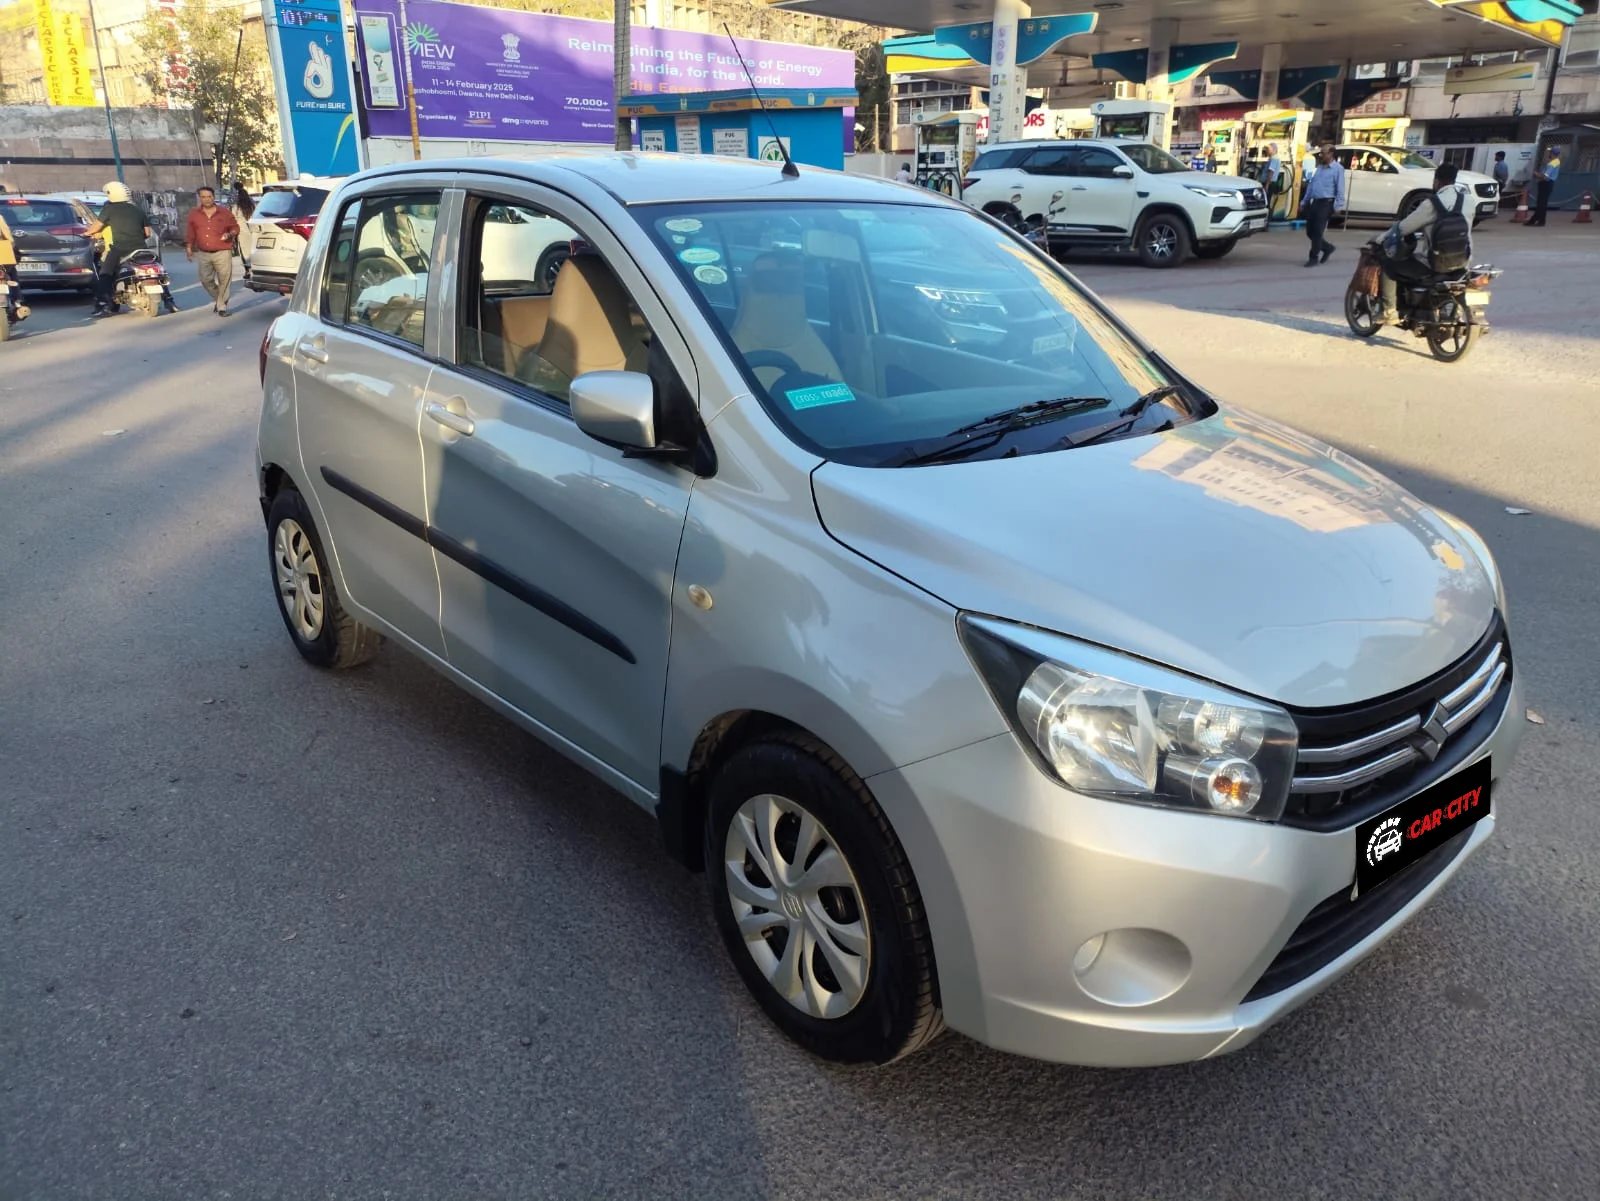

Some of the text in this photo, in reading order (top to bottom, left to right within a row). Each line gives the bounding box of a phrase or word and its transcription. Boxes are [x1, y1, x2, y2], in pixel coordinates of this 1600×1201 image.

[64, 27, 84, 95] CLASSIC
[420, 43, 455, 59] IEW
[568, 38, 822, 76] Reimgining the Future of Energy
[640, 62, 683, 77] India,
[687, 67, 710, 78] for
[712, 69, 736, 80] the
[739, 71, 784, 86] World.
[456, 81, 492, 91] February
[494, 83, 514, 91] 2025
[565, 97, 608, 107] 70,000+
